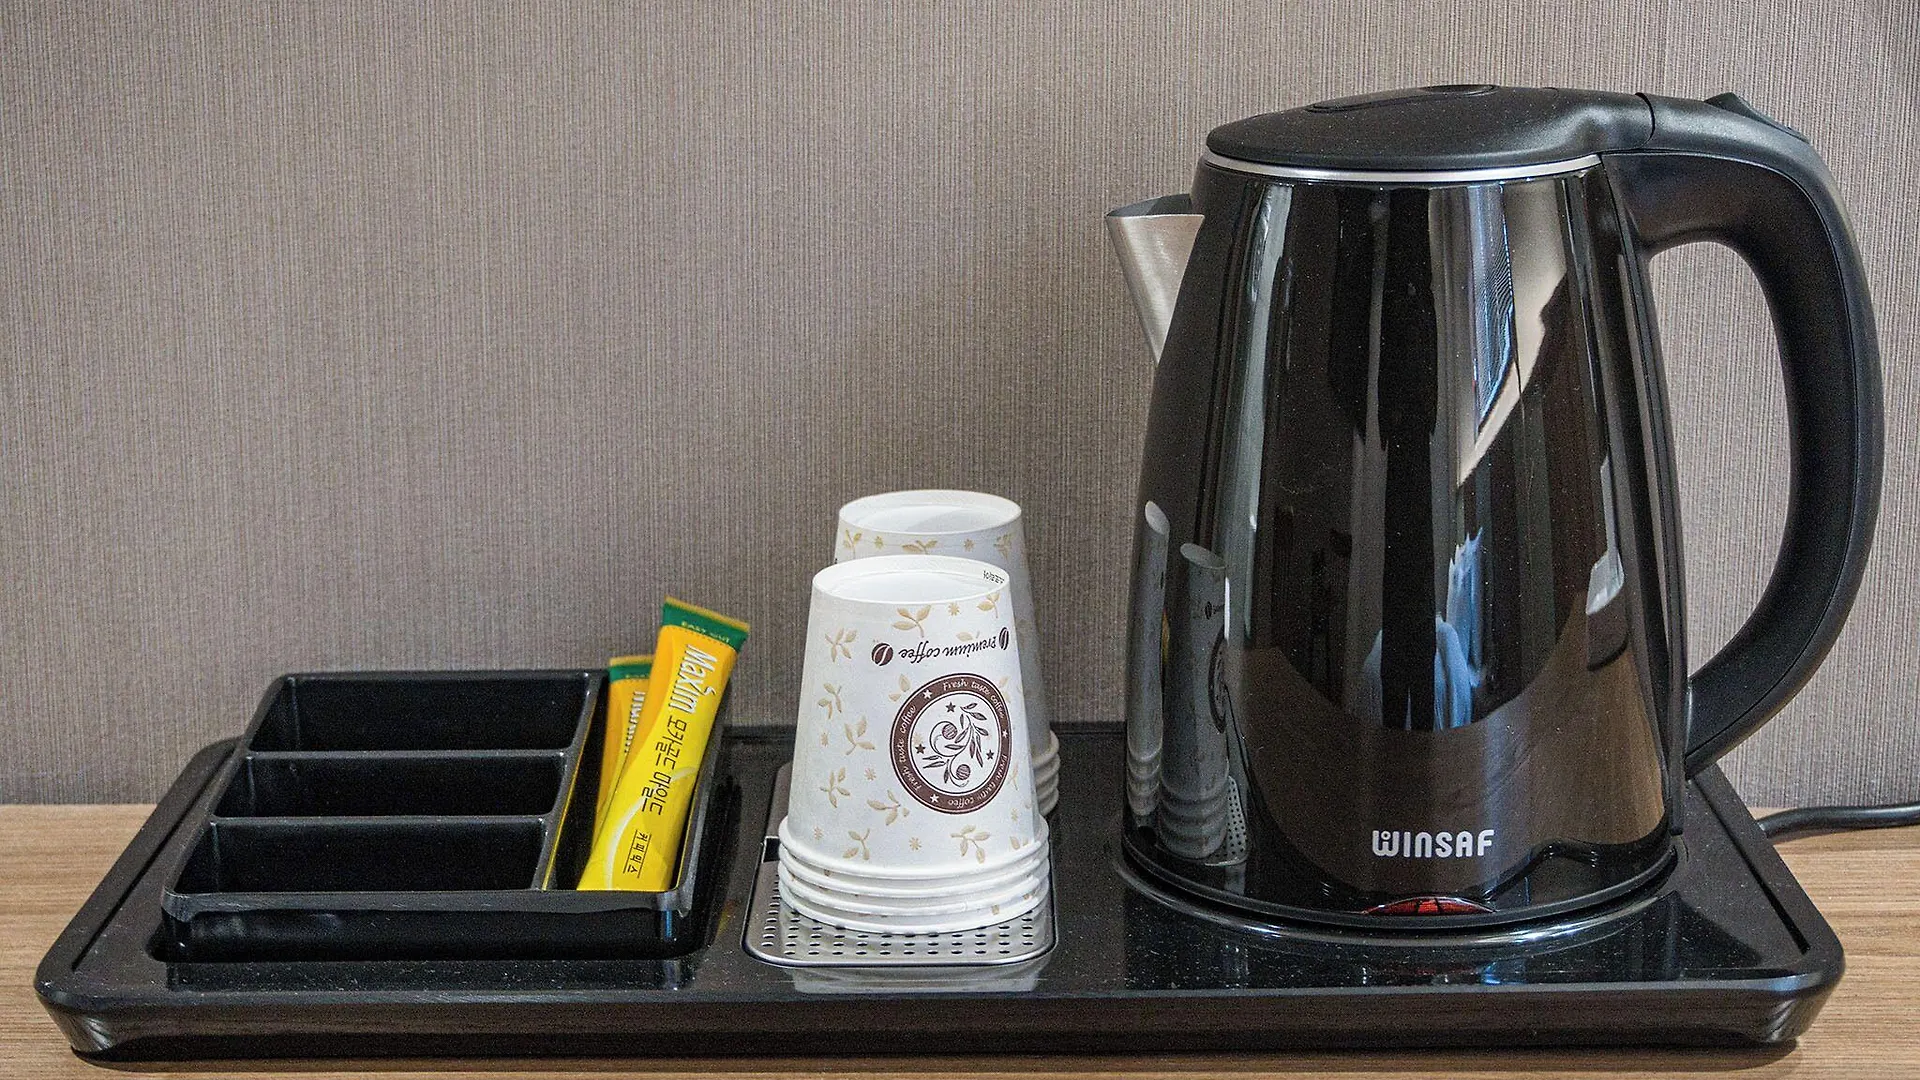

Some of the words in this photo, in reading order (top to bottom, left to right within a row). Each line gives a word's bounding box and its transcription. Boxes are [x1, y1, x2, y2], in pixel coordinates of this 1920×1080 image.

[898, 640, 940, 664] coffee
[942, 636, 997, 658] Premium
[667, 644, 717, 715] Maxim
[943, 676, 968, 691] Fresh
[971, 681, 991, 696] taste
[990, 693, 1006, 719] coffee
[898, 704, 917, 734] coffee
[655, 717, 688, 770] 모카골드
[897, 738, 907, 763] taste
[901, 766, 922, 792] Fresh
[641, 773, 672, 816] 마일드
[947, 796, 975, 809] coffee
[629, 832, 650, 875] 커피믹스
[1371, 829, 1495, 858] WINSAF
